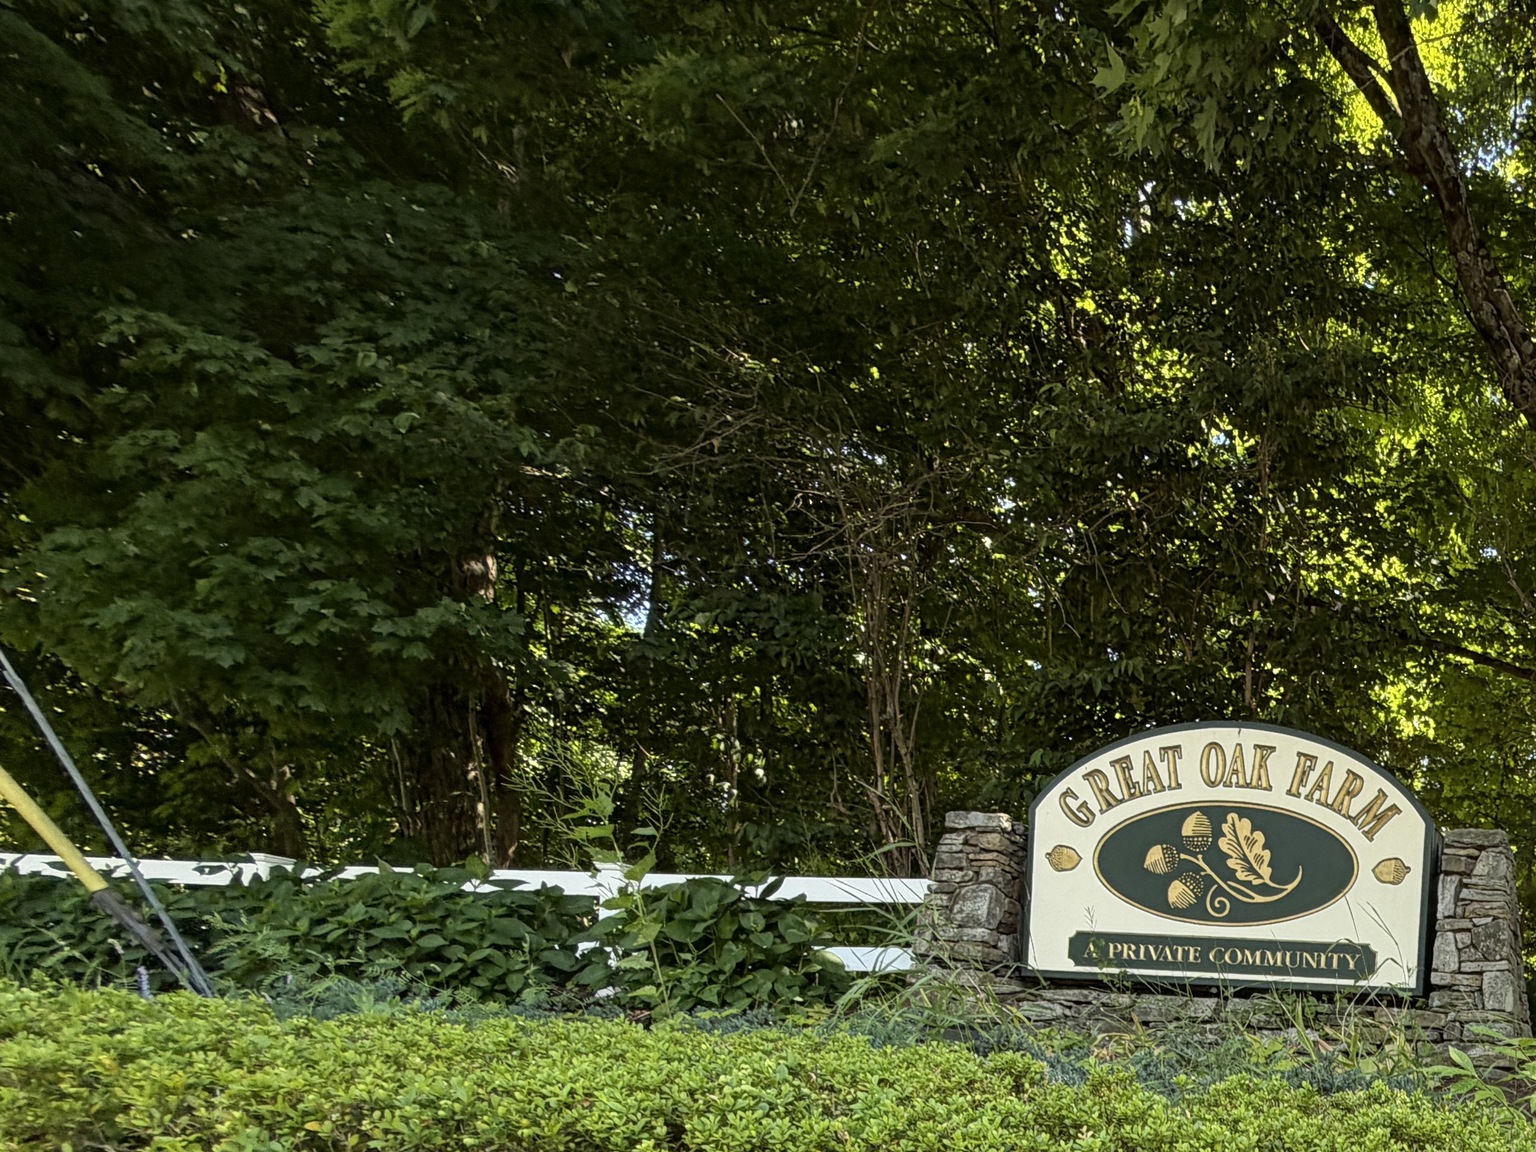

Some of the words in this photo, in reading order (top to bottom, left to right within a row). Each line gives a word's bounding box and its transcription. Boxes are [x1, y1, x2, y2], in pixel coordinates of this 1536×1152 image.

[1058, 743, 1183, 829] GREAT
[1199, 741, 1277, 792] OAK
[1286, 750, 1402, 843] FARM
[1083, 942, 1099, 959] A
[1107, 942, 1202, 964] PRIVATE
[1208, 946, 1361, 971] COMMUNITY
